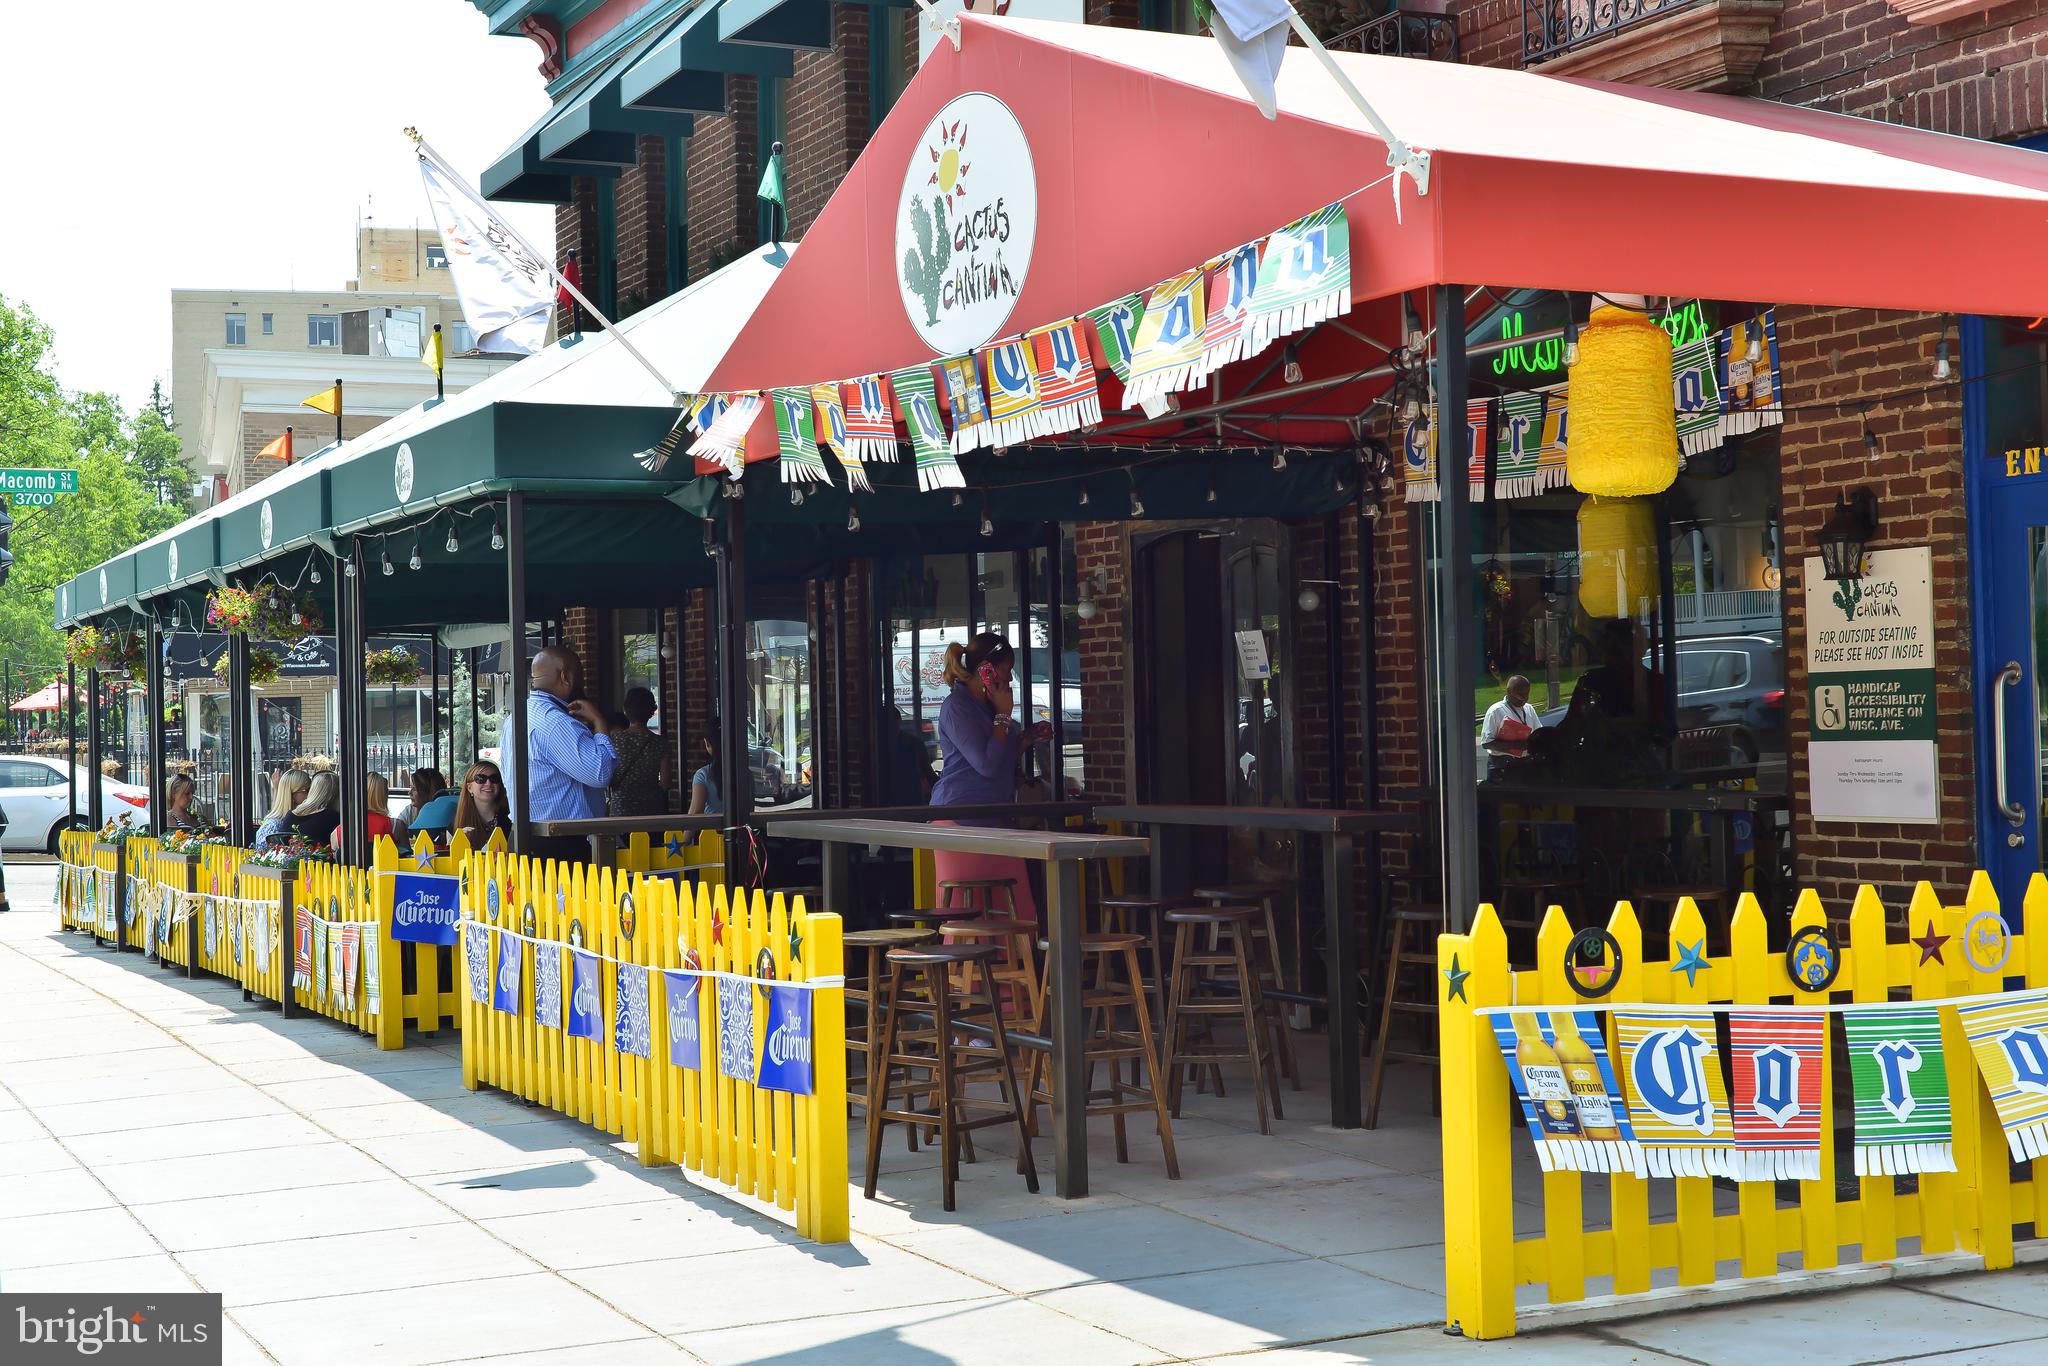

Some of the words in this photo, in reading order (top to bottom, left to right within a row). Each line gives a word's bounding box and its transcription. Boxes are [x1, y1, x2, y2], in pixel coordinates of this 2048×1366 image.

[954, 197, 1010, 252] CACTUS
[943, 248, 1017, 311] CANTINA
[2005, 446, 2048, 477] EN
[60, 472, 71, 481] St
[15, 493, 53, 505] 3700
[1863, 580, 1898, 599] CACTUS
[1819, 631, 1836, 645] FOR
[1838, 628, 1876, 644] OUTSIDE
[1878, 625, 1917, 642] SEATING
[1814, 648, 1845, 662] PLEASE
[1846, 647, 1863, 661] SEE
[1865, 645, 1889, 661] HOST
[1891, 644, 1924, 660] INSIDE
[1847, 682, 1901, 694] HANDICAP
[1848, 694, 1926, 706] ACCESSIBILITY
[1848, 707, 1905, 718] ENTRANCE
[1907, 706, 1923, 718] ON
[1848, 720, 1878, 731] WISC.
[1880, 719, 1904, 731] AVE.
[415, 890, 440, 906] Jose
[395, 899, 454, 926] Cuervo
[669, 1006, 697, 1043] Cuervo
[786, 1009, 802, 1032] Jose
[768, 1023, 811, 1066] Cuervo
[1526, 1066, 1561, 1081] Corona
[1538, 1079, 1559, 1088] Extra
[1570, 1080, 1604, 1095] Corona
[1578, 1096, 1603, 1109] Light
